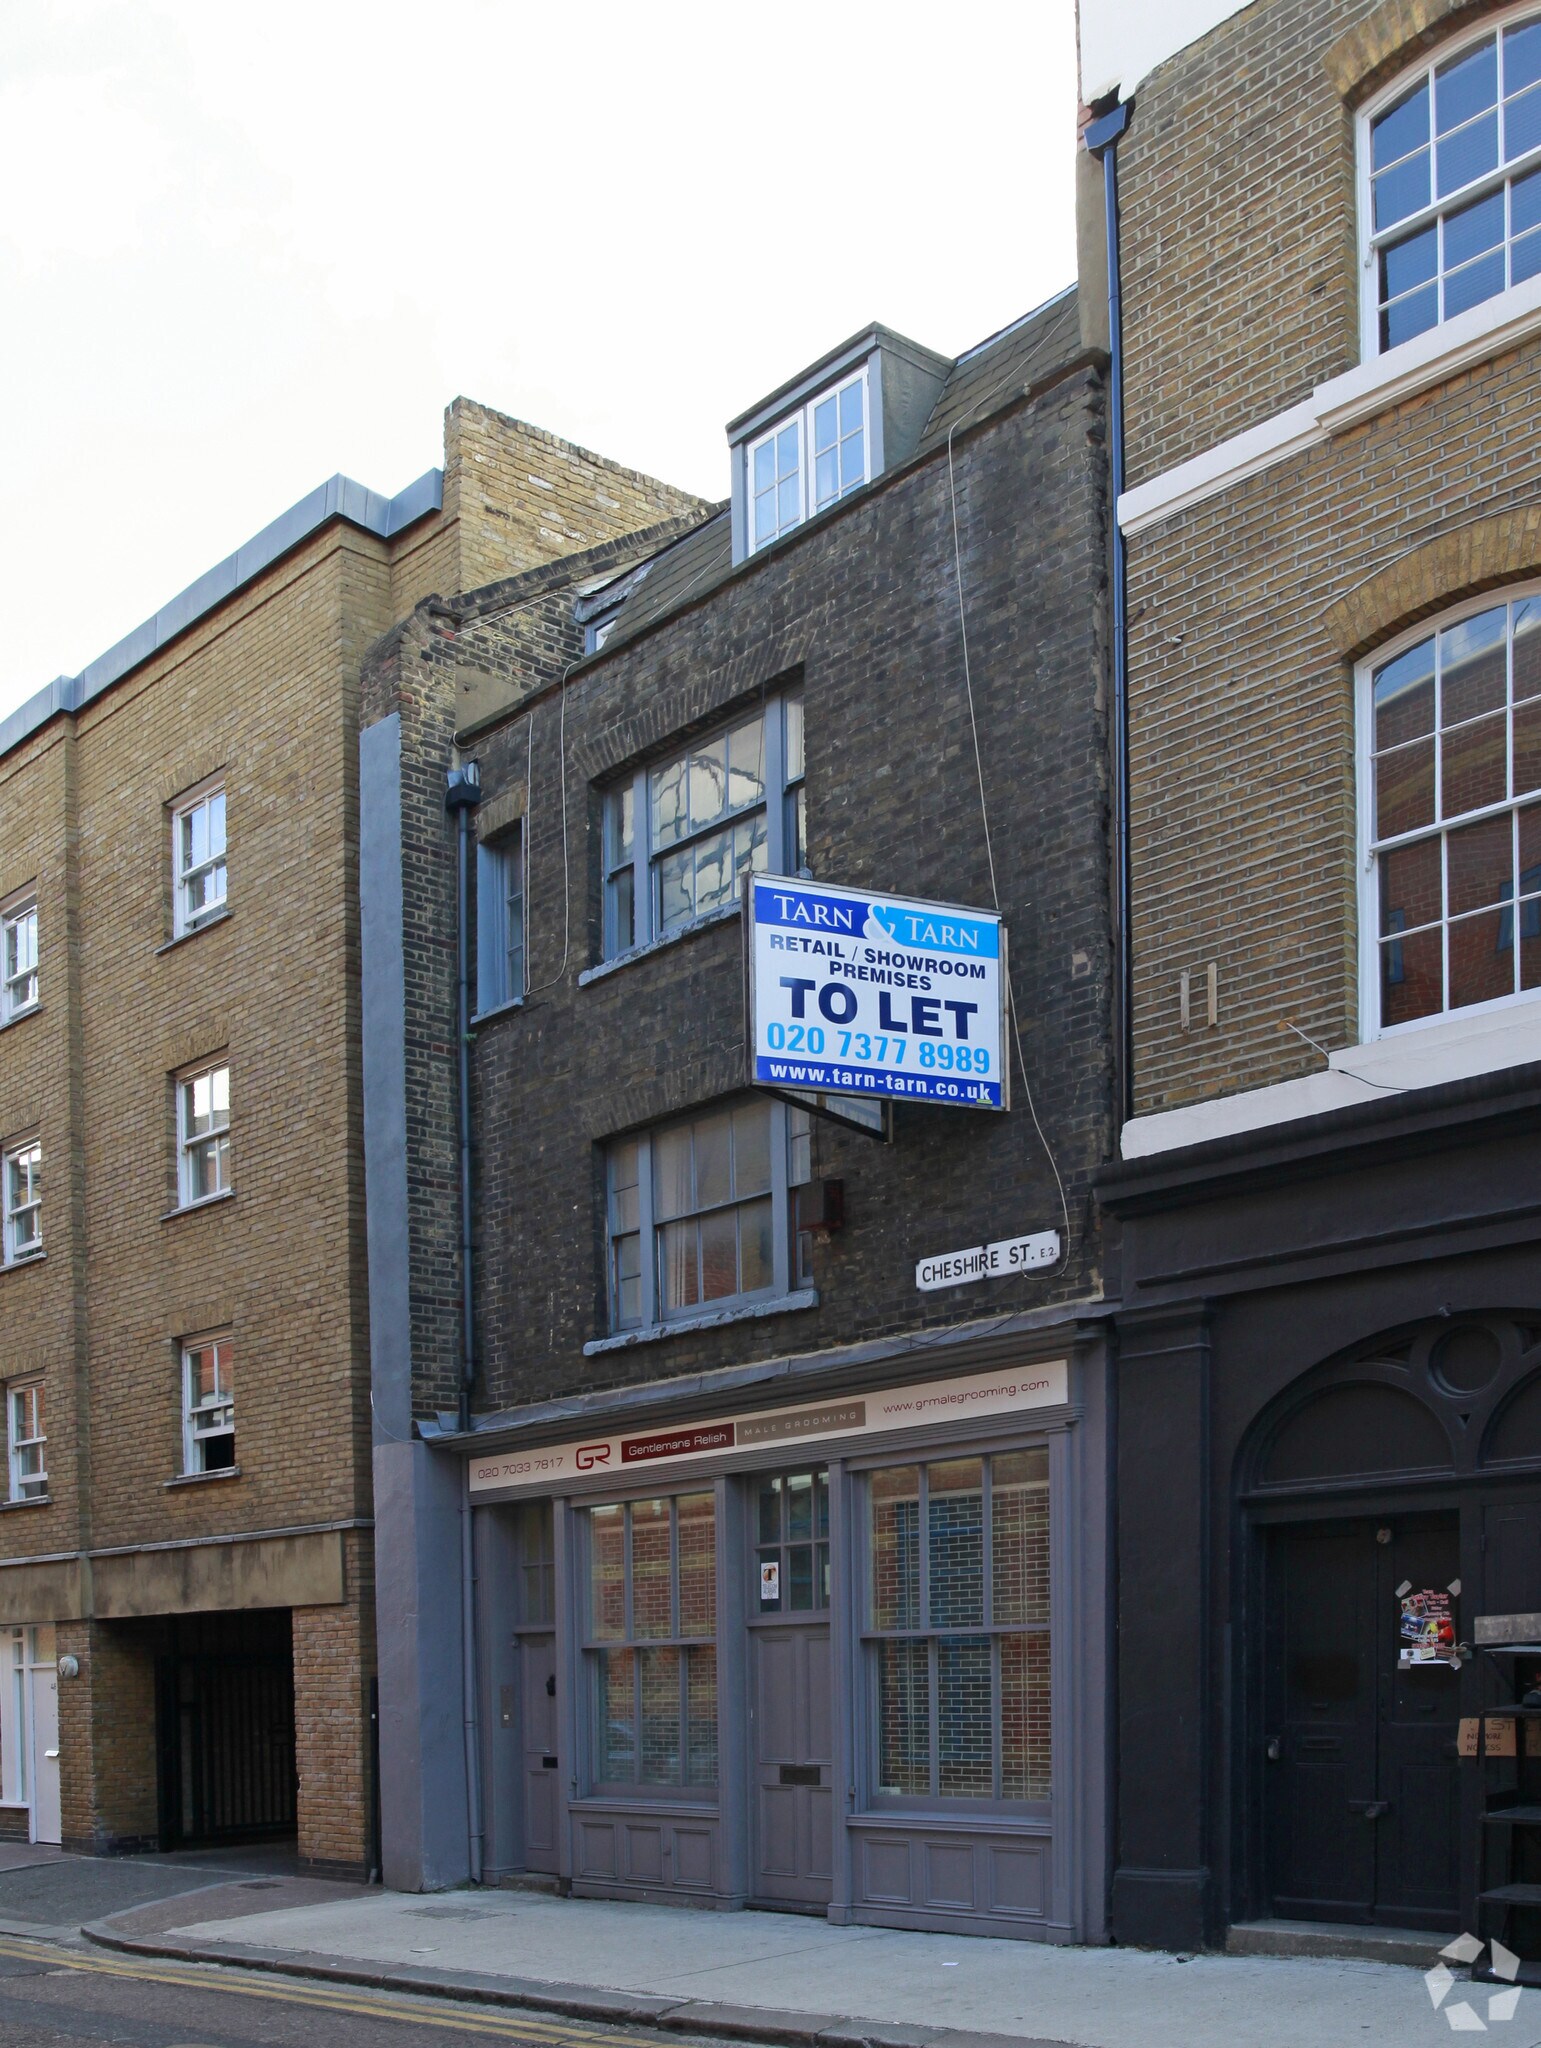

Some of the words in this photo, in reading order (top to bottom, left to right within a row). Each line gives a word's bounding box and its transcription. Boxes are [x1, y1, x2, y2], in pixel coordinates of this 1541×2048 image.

[773, 894, 853, 930] TARN
[862, 903, 895, 944] &
[904, 916, 978, 950] TARN
[770, 934, 845, 959] RETAIL
[864, 948, 986, 979] SHOWROOM
[829, 961, 932, 991] PREMISES
[779, 976, 858, 1024] TO
[879, 991, 978, 1040] LET
[767, 1022, 825, 1055] 020
[837, 1030, 907, 1064] 7377
[919, 1041, 990, 1074] 8989
[769, 1063, 991, 1101] www.tarn-tarn.co.uk
[922, 1250, 999, 1283] CHESHIRE
[1009, 1243, 1034, 1264] ST.
[883, 1378, 1050, 1414] www.grmalegrooming.com
[744, 1423, 777, 1437] MALE
[785, 1411, 857, 1430] GROOMING
[628, 1438, 691, 1456] Gentlemans
[693, 1432, 727, 1450] Relish
[477, 1466, 499, 1480] 020
[502, 1461, 531, 1476] 7033
[535, 1457, 564, 1471] 7817
